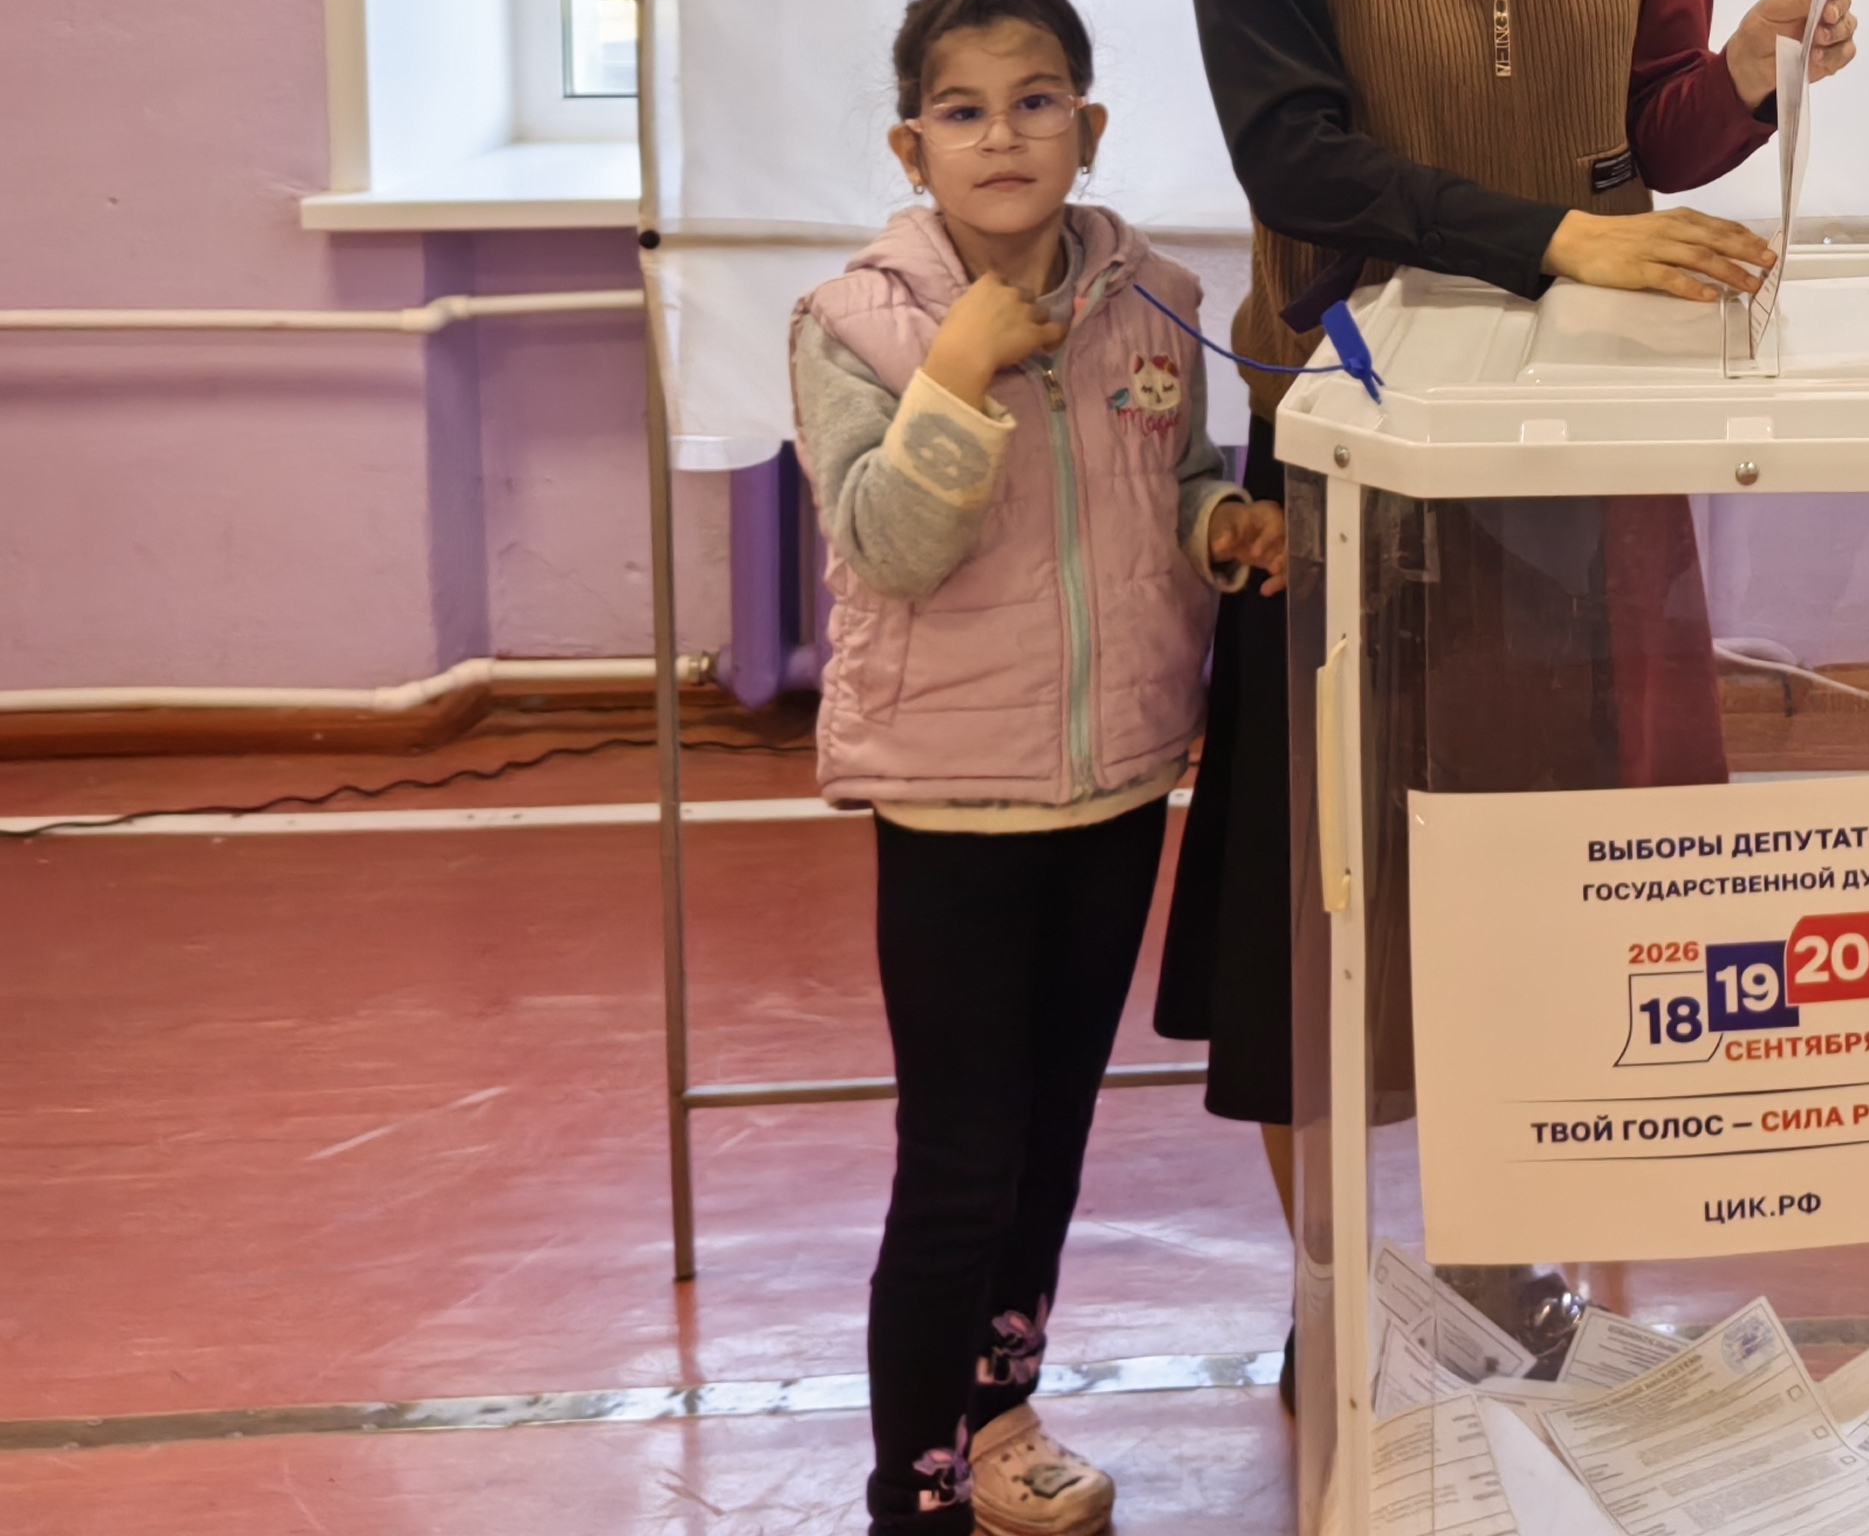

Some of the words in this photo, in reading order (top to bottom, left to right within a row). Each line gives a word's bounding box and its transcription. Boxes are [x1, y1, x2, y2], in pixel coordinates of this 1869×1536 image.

[1587, 834, 1723, 862] ВЫБОРЫ
[1582, 866, 1835, 901] ГОСУДАРСТВЕННОЙ
[1628, 941, 1700, 964] 2026
[1639, 996, 1703, 1045] 18
[1715, 962, 1780, 1014] 19
[1530, 1115, 1613, 1144] ТВОЙ
[1622, 1114, 1724, 1141] ГОЛОС
[1760, 1105, 1845, 1133] СИЛА
[1703, 1191, 1822, 1224] ЦИК.РФ
